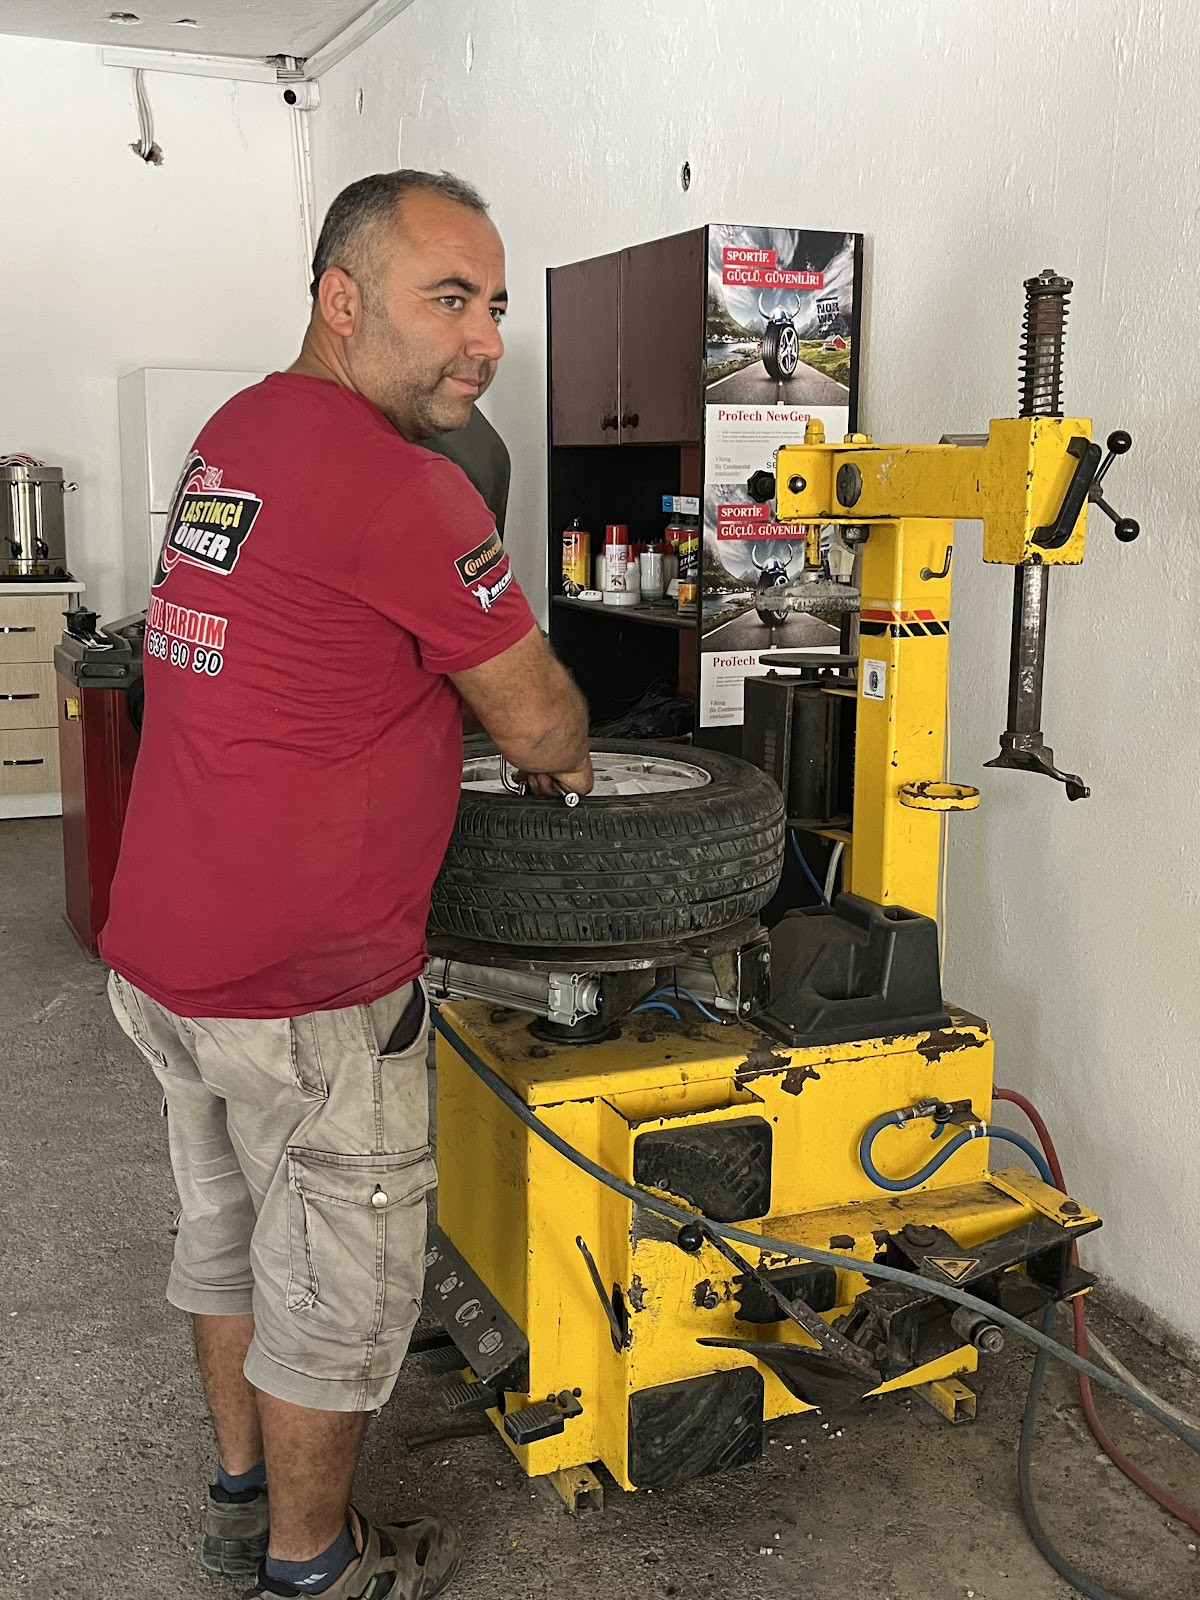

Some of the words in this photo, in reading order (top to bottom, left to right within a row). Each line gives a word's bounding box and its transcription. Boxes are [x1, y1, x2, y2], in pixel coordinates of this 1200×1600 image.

[727, 249, 769, 262] SPORTİF.
[727, 269, 762, 283] GÜÇLÜ.
[765, 271, 819, 285] GÜVENİLİR!
[817, 302, 840, 313] NOR
[718, 410, 762, 421] ProTech
[767, 410, 811, 421] NewGen
[180, 498, 244, 530] LASTİKÇİ
[721, 505, 762, 517] SPORTİF.
[721, 525, 756, 538] GÜÇLÜ.
[174, 523, 231, 561] ÖMER
[491, 567, 512, 597] MICH
[165, 603, 227, 649] YARDIM
[148, 631, 168, 659] 633
[171, 641, 189, 667] 90
[193, 648, 222, 675] 90
[713, 656, 755, 667] ProTech
